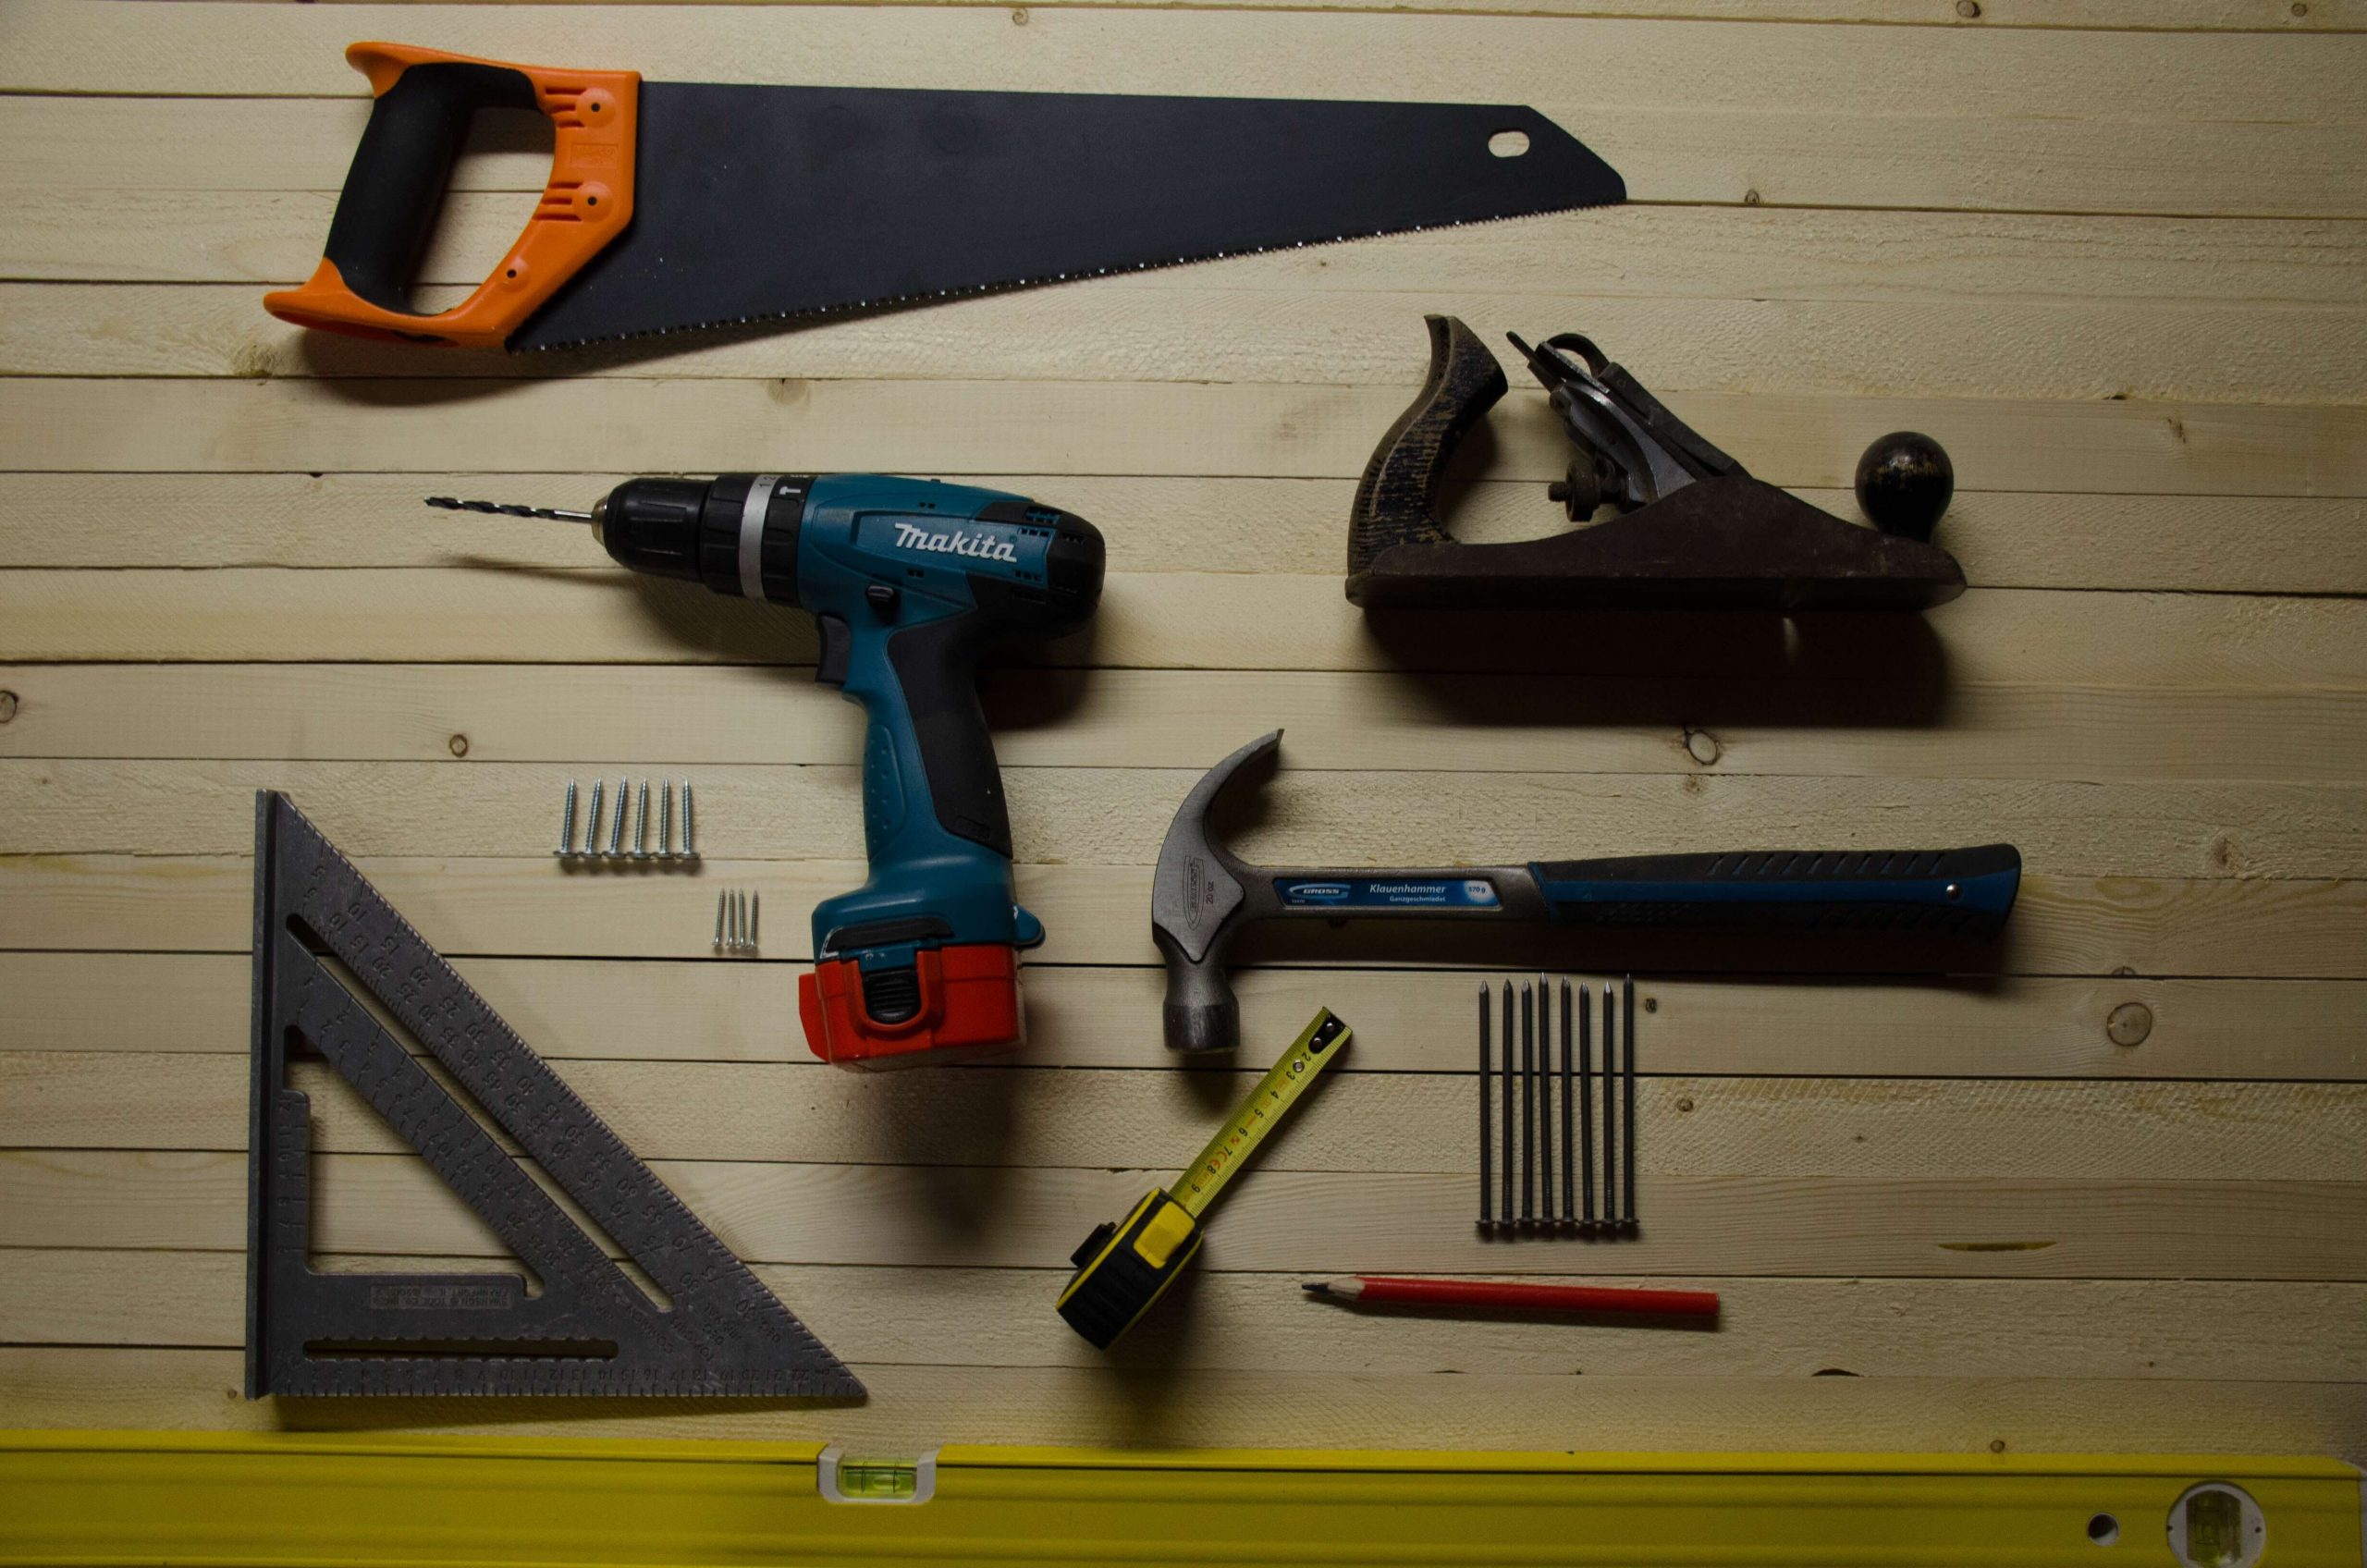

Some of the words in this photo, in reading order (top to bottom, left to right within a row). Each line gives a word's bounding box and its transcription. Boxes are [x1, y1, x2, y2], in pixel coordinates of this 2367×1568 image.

[1207, 880, 1214, 892] oz
[1369, 883, 1446, 895] Klauenhammer
[1205, 893, 1214, 905] 20
[1389, 895, 1446, 904] Ganzgeschmiedet
[1301, 1052, 1310, 1060] 2
[1285, 1071, 1294, 1080] 3
[1269, 1089, 1280, 1098] 4
[1254, 1109, 1263, 1117] 5
[1238, 1127, 1247, 1135] 6
[1222, 1145, 1232, 1155] 7
[1207, 1165, 1216, 1173] 8
[1191, 1183, 1200, 1193] 9
